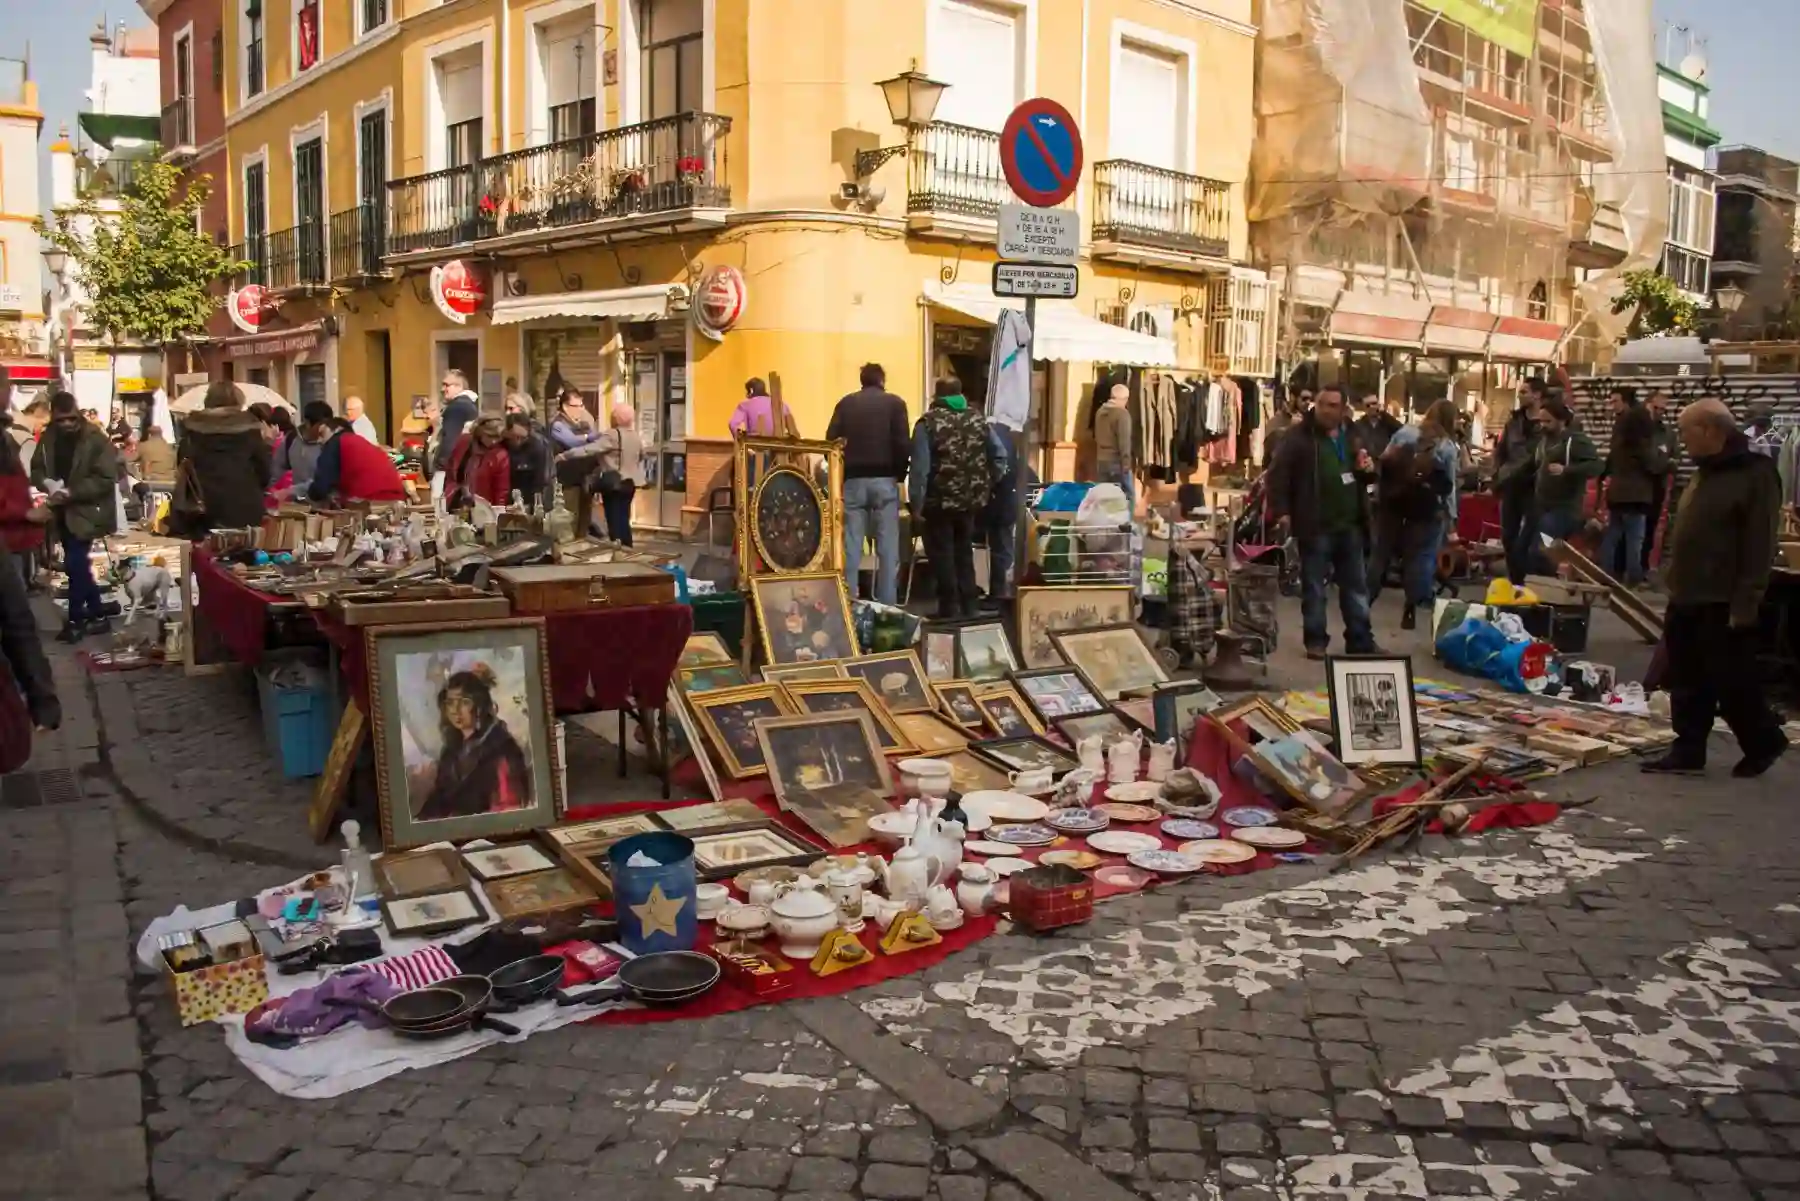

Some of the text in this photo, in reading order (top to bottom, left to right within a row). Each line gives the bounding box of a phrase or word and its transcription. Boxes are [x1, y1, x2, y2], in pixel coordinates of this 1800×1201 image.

[1024, 234, 1056, 244] EXCEPTO
[1004, 242, 1028, 252] CARGA
[1038, 246, 1075, 256] DESCARGA
